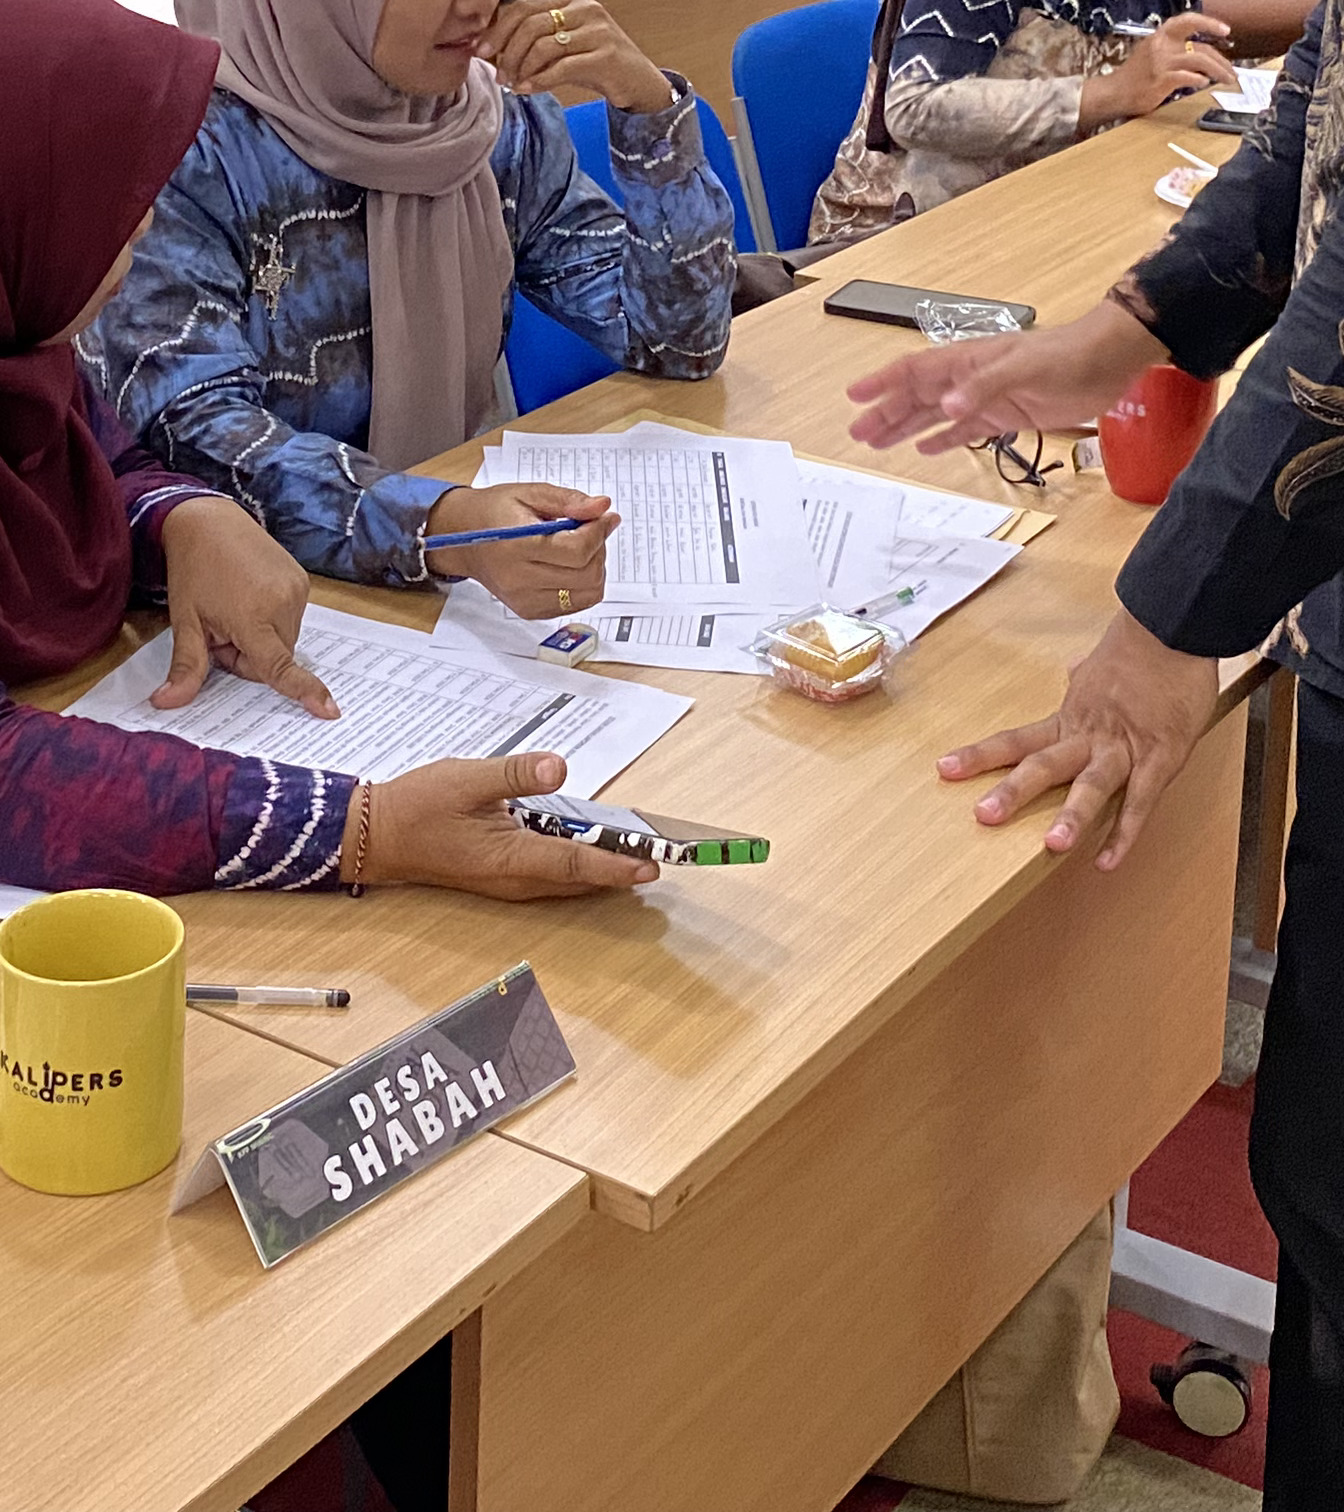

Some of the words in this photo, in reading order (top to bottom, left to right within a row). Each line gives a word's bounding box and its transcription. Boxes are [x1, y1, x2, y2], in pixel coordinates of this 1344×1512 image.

[12, 1081, 91, 1107] academy
[322, 1059, 507, 1202] SHABAH
[348, 1050, 449, 1132] DESA
